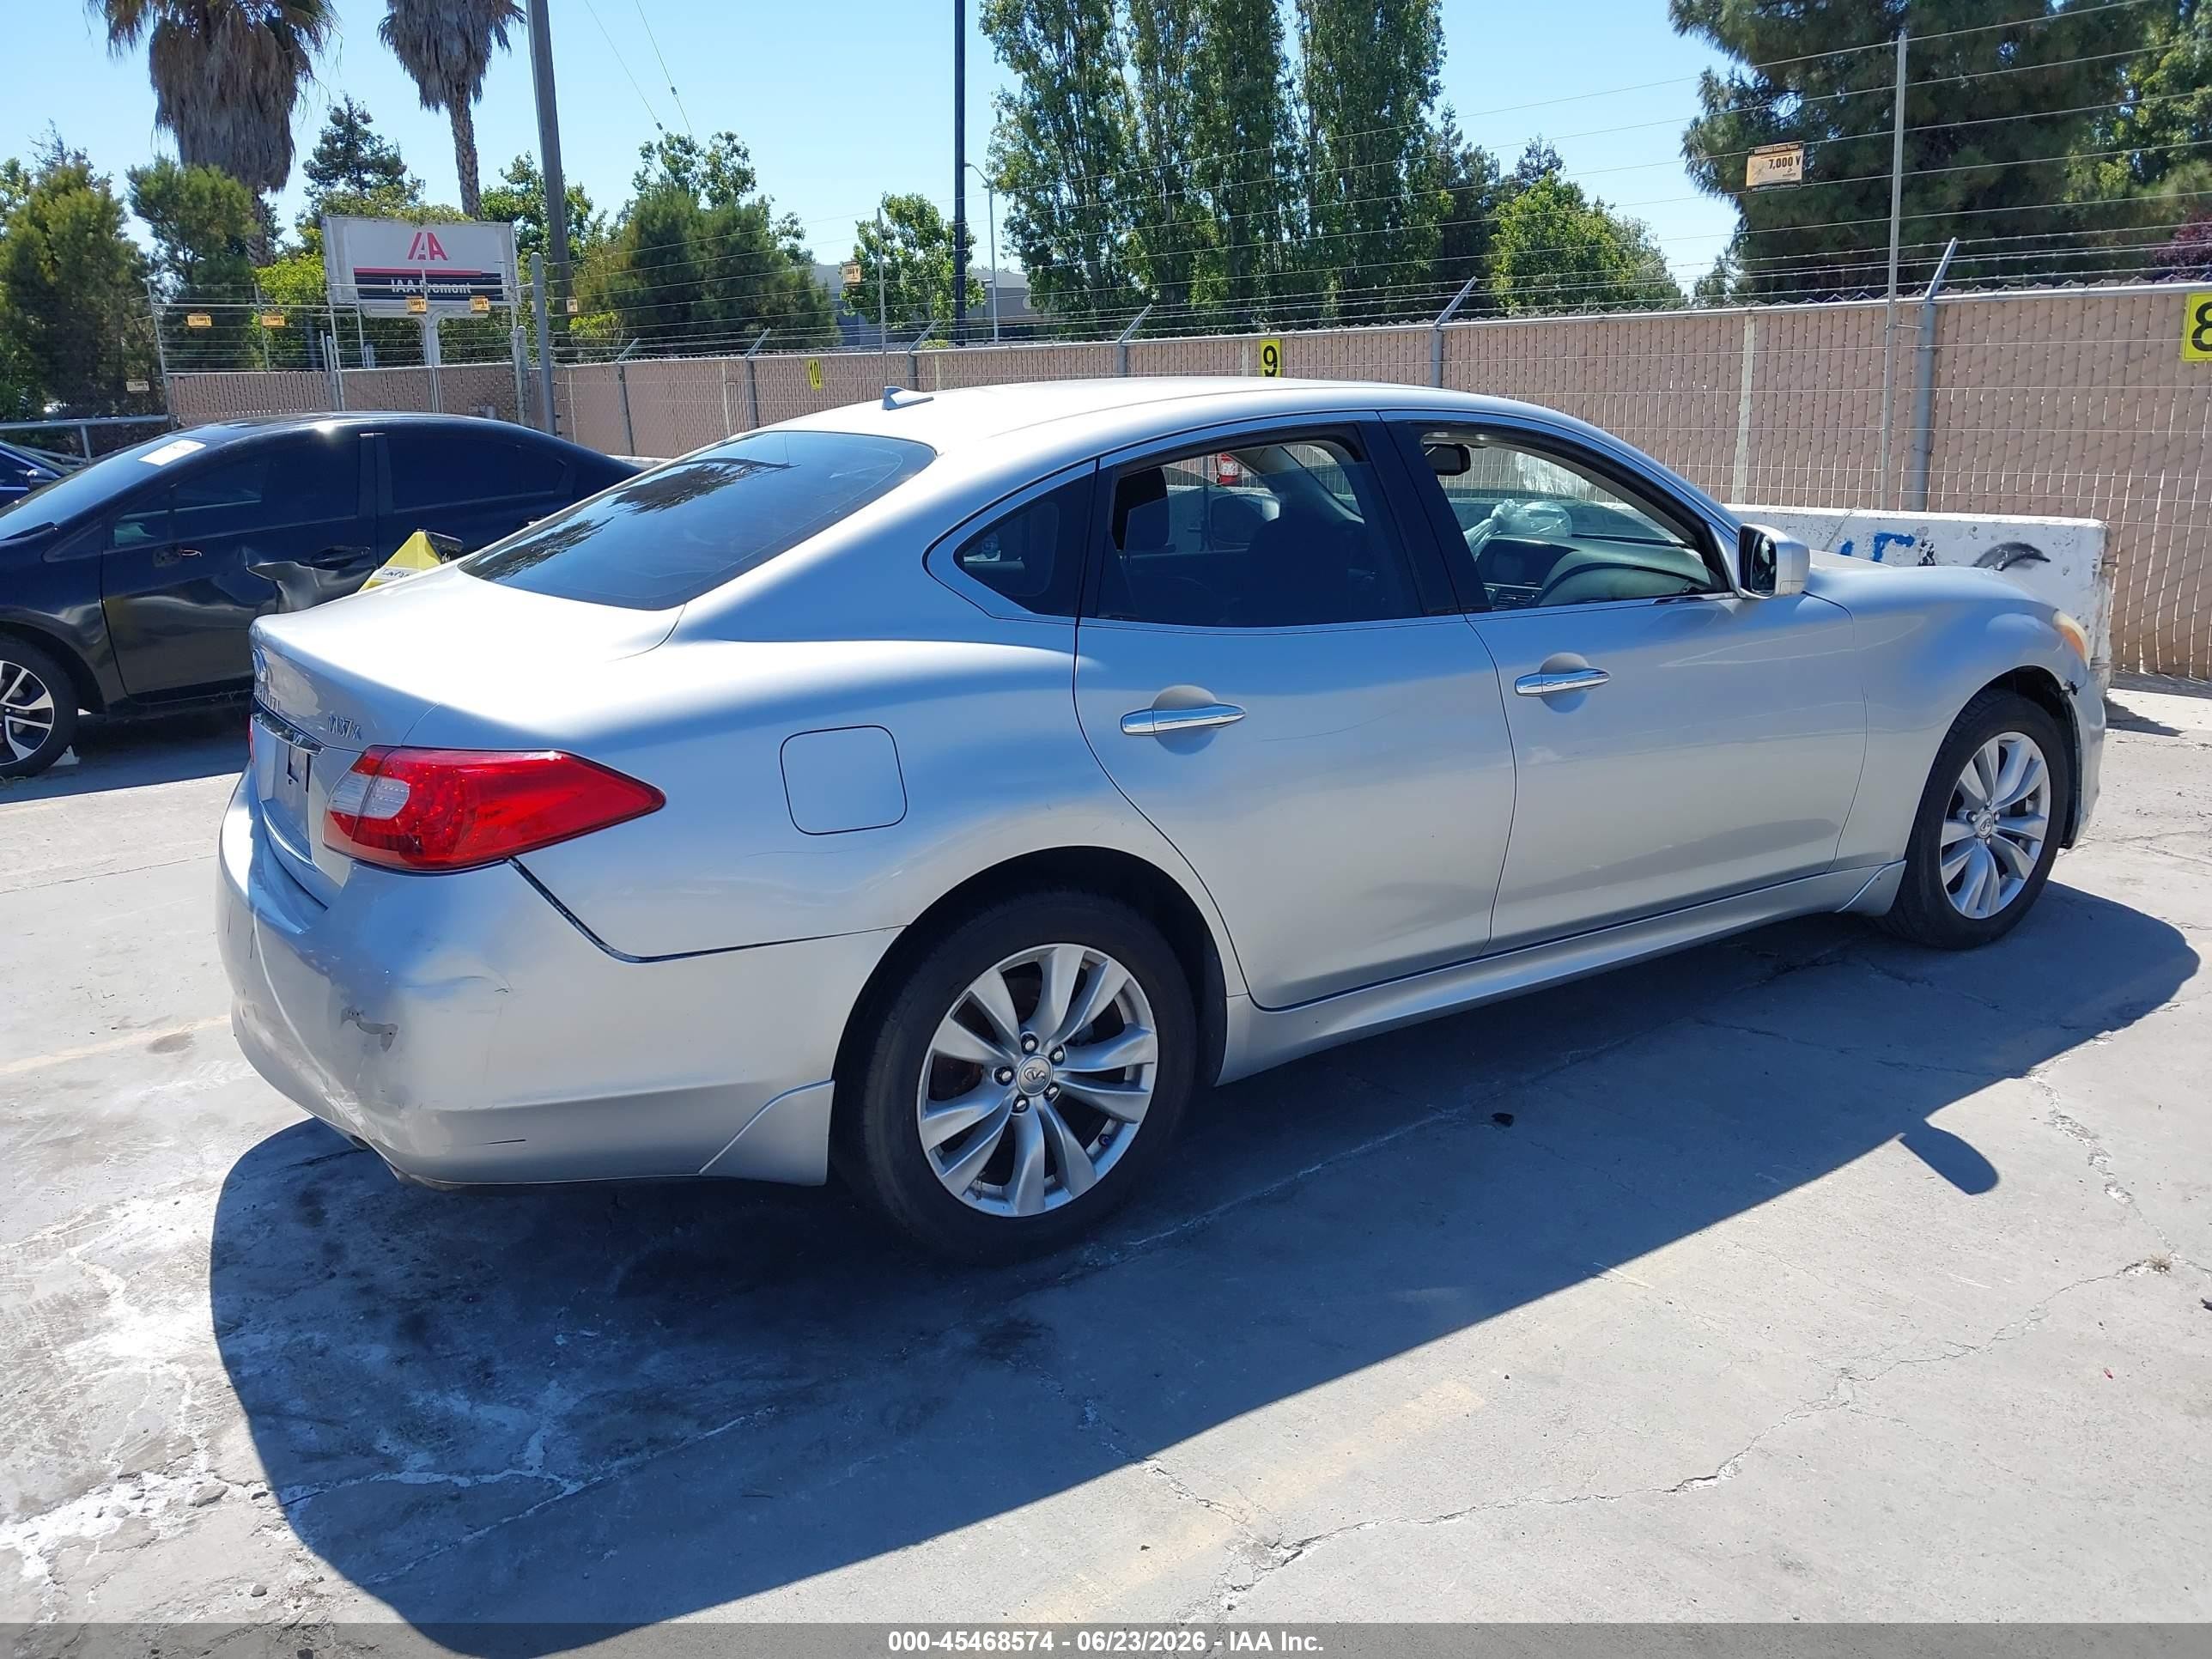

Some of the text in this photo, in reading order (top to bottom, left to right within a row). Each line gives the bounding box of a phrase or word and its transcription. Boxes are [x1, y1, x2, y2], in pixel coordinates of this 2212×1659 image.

[1769, 156, 1793, 170] 7,000
[1796, 155, 1802, 165] V
[391, 279, 472, 294] IAA Fremont
[1263, 345, 1278, 377] 9
[810, 361, 820, 386] 10
